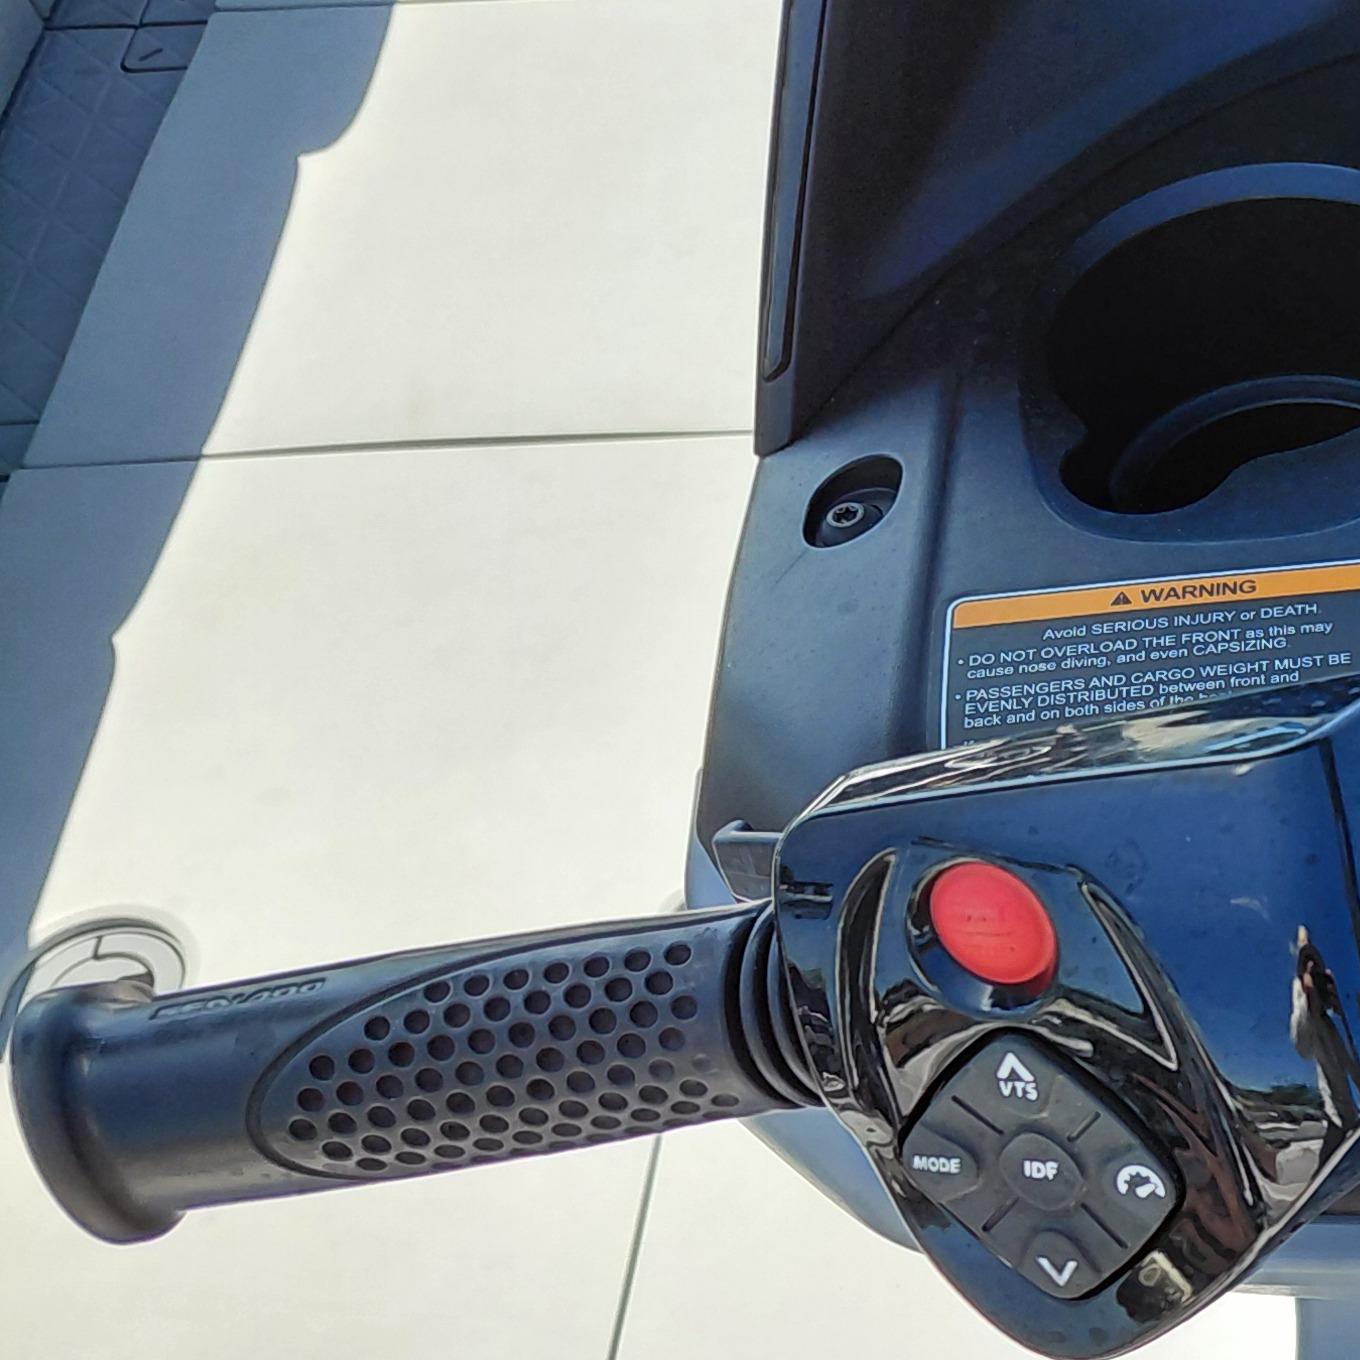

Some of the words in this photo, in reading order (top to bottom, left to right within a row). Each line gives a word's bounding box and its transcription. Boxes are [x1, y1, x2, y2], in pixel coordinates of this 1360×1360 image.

[1140, 579, 1257, 603] WARNING
[1042, 625, 1086, 641] Avoid
[1091, 617, 1168, 635] SERIOUS
[1174, 610, 1236, 627] INJURY
[1240, 610, 1256, 621] or
[969, 654, 995, 666] DO
[1001, 649, 1037, 664] NOT
[1041, 639, 1137, 659] OVERLOAD
[1143, 635, 1176, 649] THE
[1182, 629, 1241, 645] FRONT
[1245, 629, 1264, 639] as
[1269, 625, 1296, 637] this
[1300, 622, 1333, 634] may
[966, 678, 1085, 701] PASSENGERS
[1089, 674, 1126, 688] AND
[1131, 668, 1194, 684] CARGO
[1200, 661, 1270, 677] WEIGHT
[1275, 655, 1324, 671] MUST
[1329, 653, 1352, 665] BE
[967, 667, 1013, 679] cause
[1019, 662, 1056, 674] nose
[1061, 655, 1111, 669] diving,
[1116, 651, 1146, 663] and
[1150, 649, 1188, 660] even
[965, 698, 1031, 715] EVENLY
[1038, 685, 1154, 707] DISTRIBUTED
[1160, 679, 1225, 694] between
[1230, 675, 1266, 687] front
[1271, 672, 1299, 683] and
[964, 715, 1001, 728] back
[1006, 711, 1035, 724] and
[1041, 710, 1060, 720] on
[1065, 704, 1099, 718] both
[1104, 699, 1145, 713] sides
[1150, 697, 1166, 709] of
[1169, 694, 1193, 705] the
[999, 1080, 1039, 1101] VTS
[912, 1156, 961, 1175] MODE
[1023, 1160, 1059, 1180] IDF
